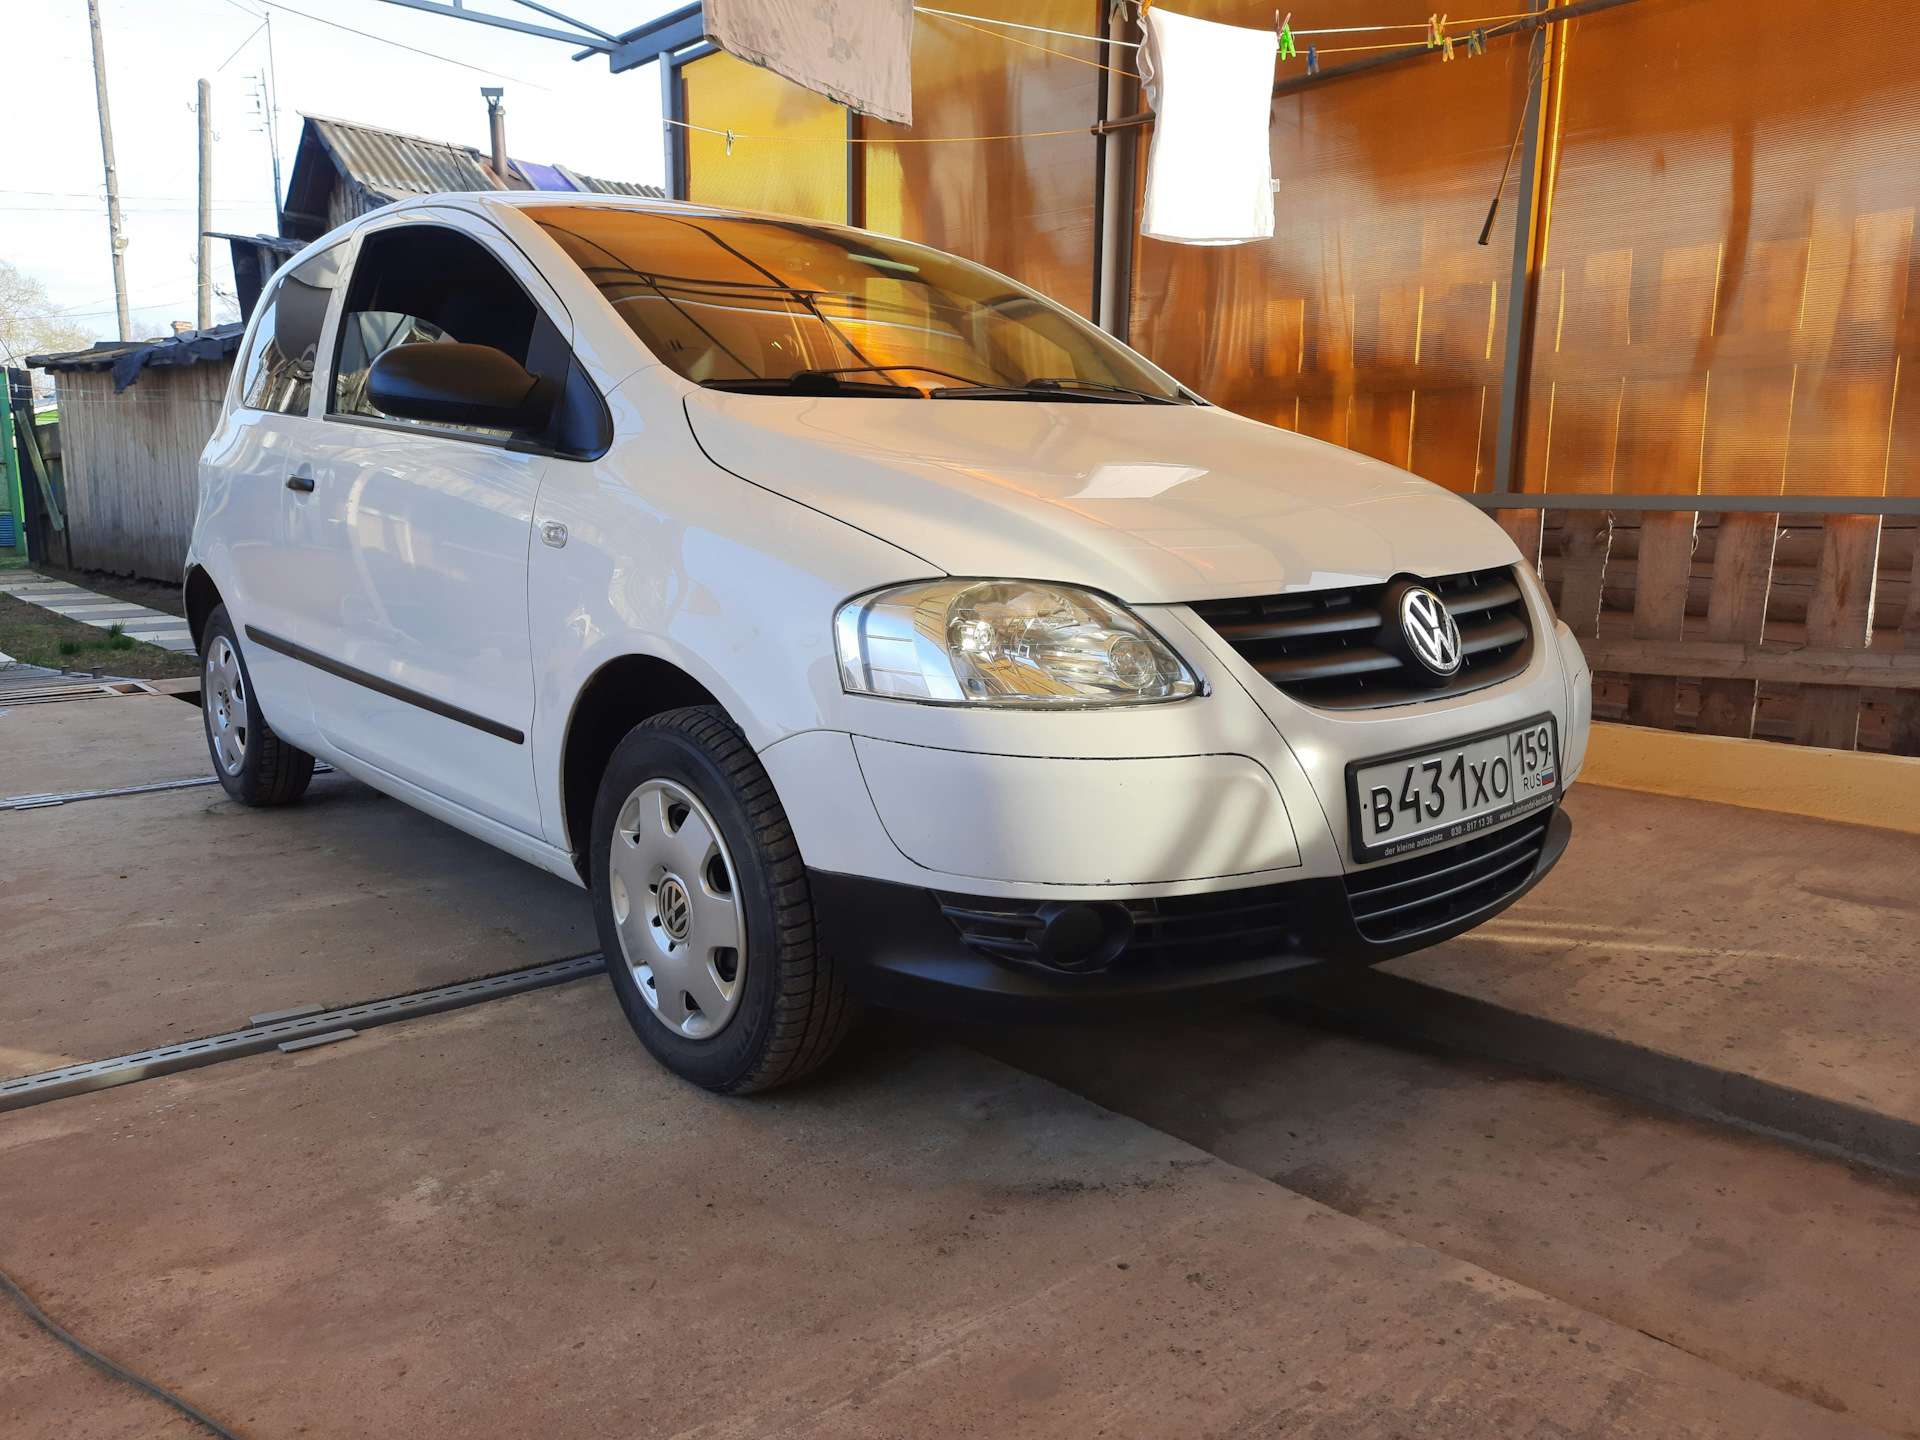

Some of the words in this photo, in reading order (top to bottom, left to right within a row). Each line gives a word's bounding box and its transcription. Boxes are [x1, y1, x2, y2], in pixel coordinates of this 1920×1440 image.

[1513, 727, 1549, 775] 159
[1523, 775, 1541, 792] RUS
[1385, 846, 1395, 856] der
[1397, 841, 1415, 852] kleine
[1416, 833, 1443, 848] autoplatz
[1467, 821, 1477, 831] 817
[660, 881, 690, 937] VW
